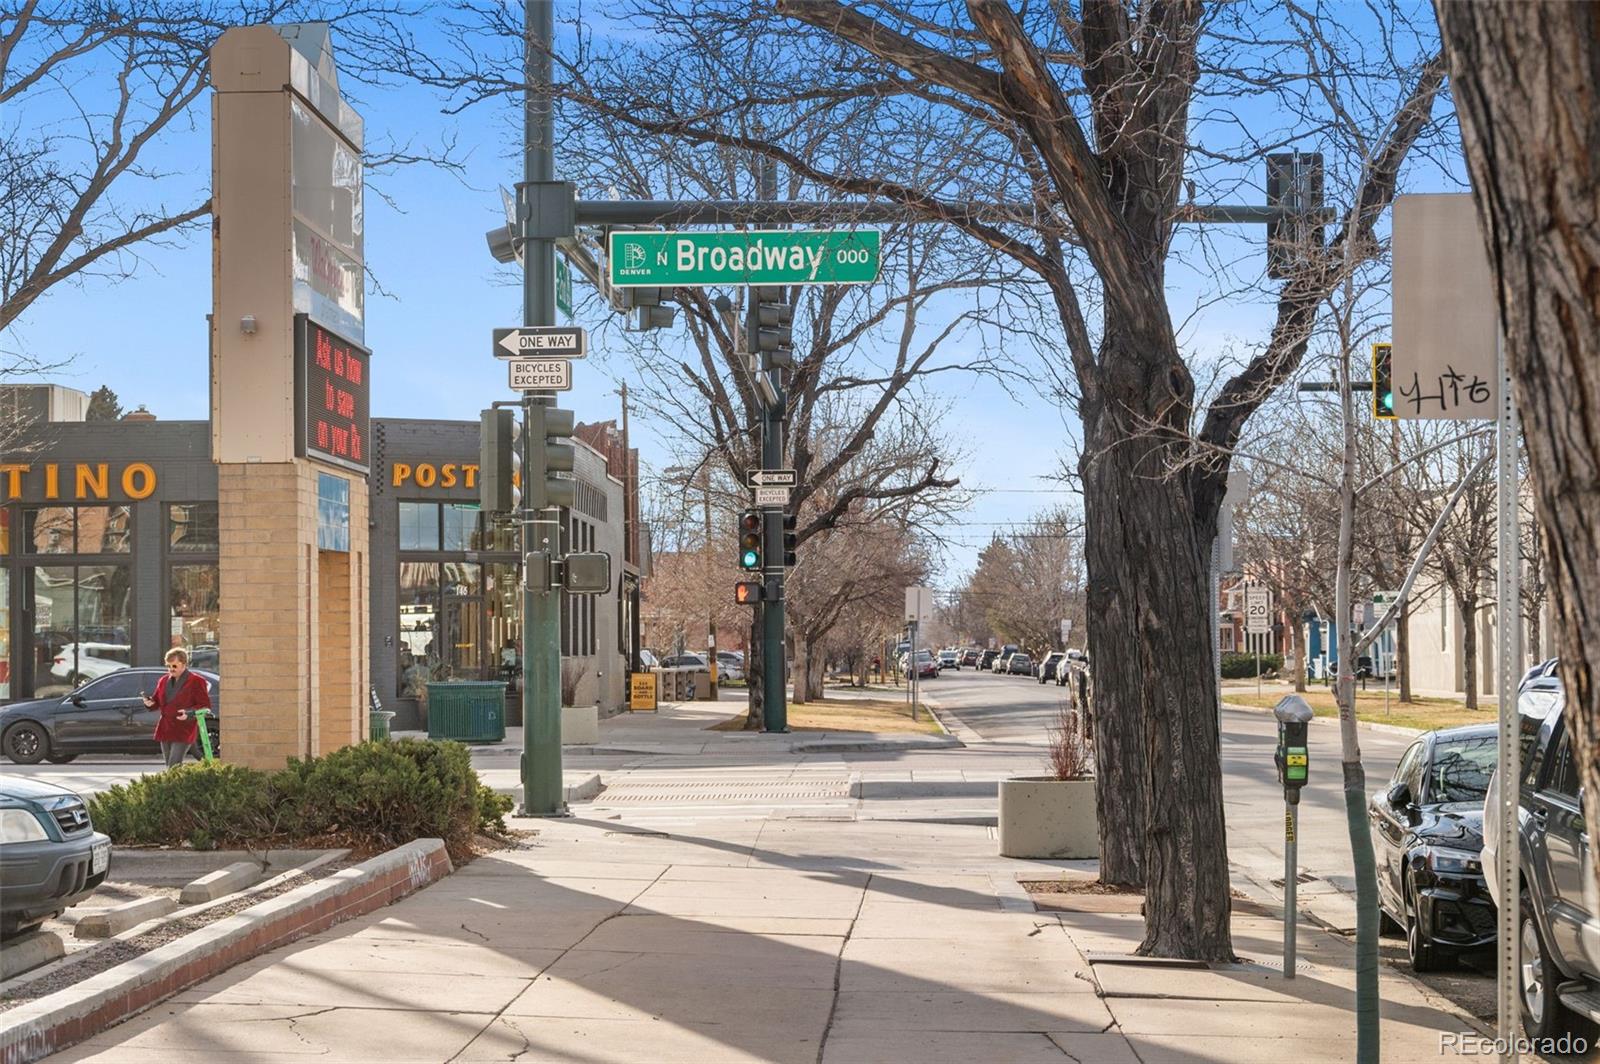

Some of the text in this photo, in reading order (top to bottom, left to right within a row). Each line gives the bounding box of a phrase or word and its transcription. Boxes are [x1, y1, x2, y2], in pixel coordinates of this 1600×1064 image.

[619, 268, 652, 276] DENVER
[656, 239, 869, 281] N Broadway 000
[519, 335, 573, 349] ONE WAY
[315, 329, 362, 386] Ask us how
[515, 363, 562, 374] BICYCLES
[513, 374, 563, 386] EXCEPTED
[325, 376, 355, 420] to save
[317, 419, 328, 450] on
[330, 425, 349, 456] your
[0, 462, 157, 500] TINO
[1249, 605, 1266, 616] 20
